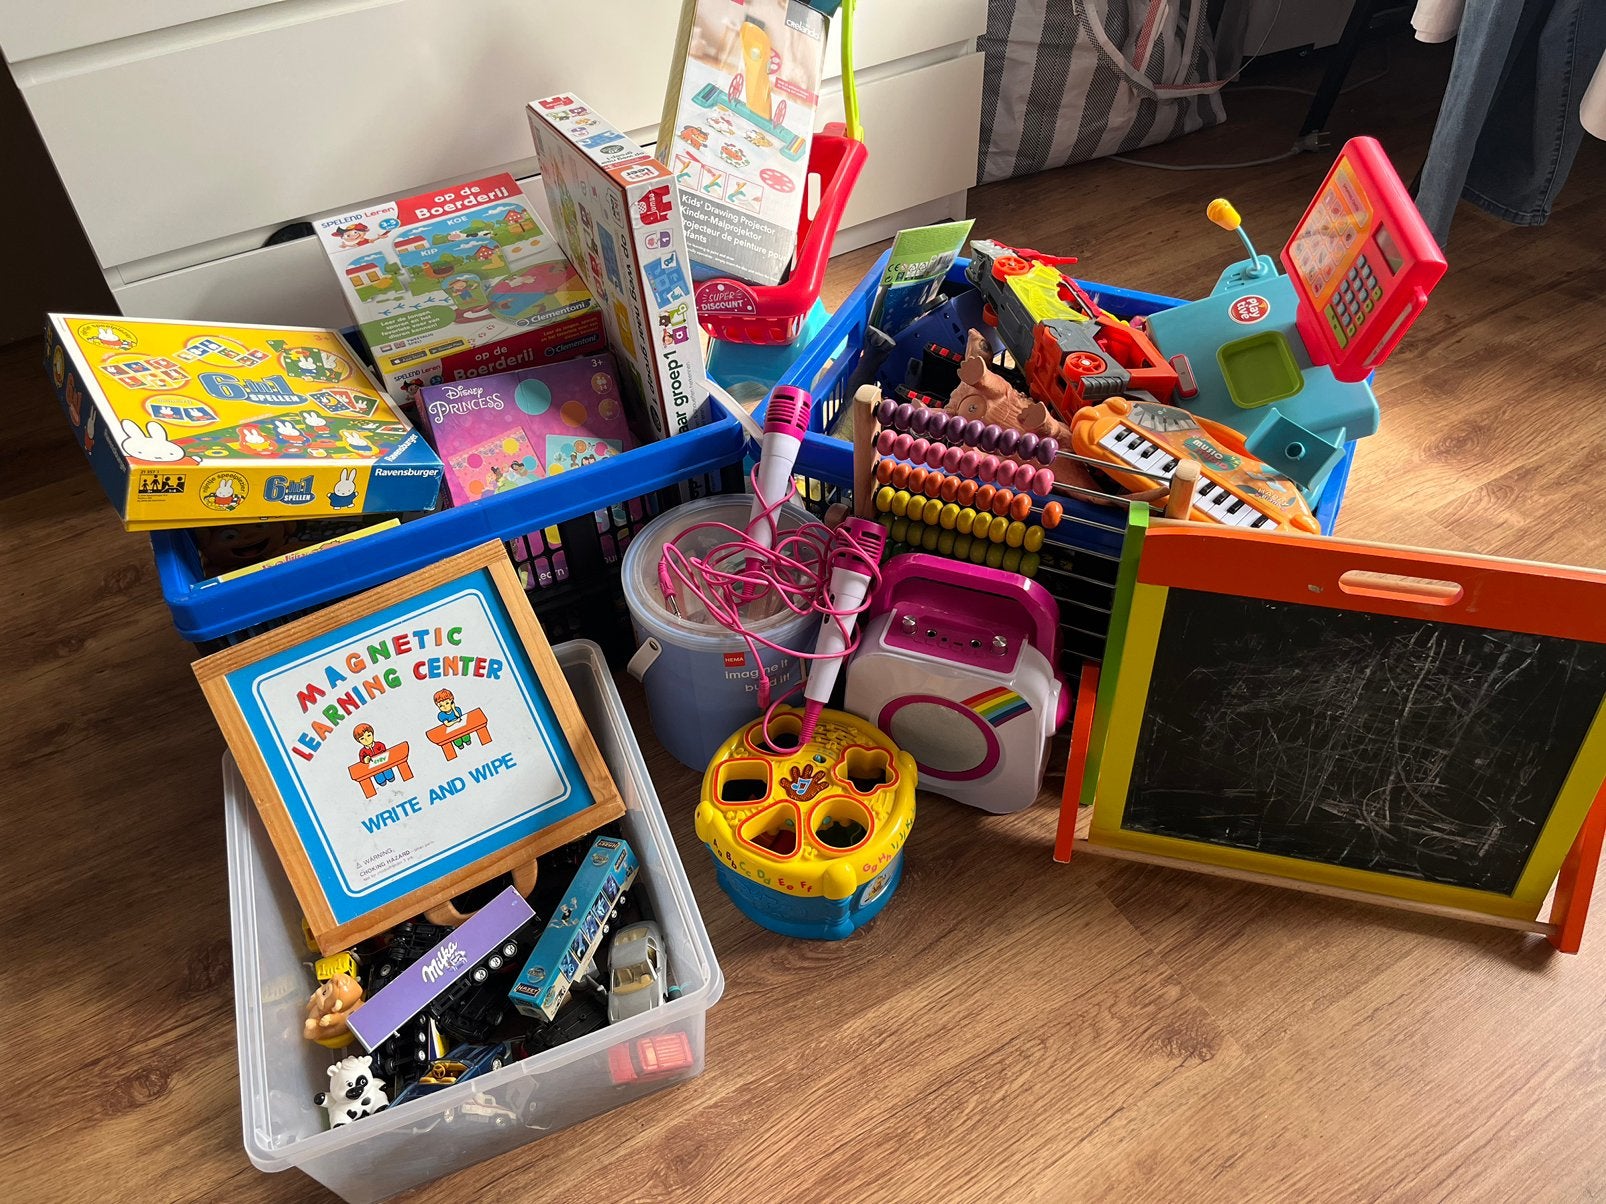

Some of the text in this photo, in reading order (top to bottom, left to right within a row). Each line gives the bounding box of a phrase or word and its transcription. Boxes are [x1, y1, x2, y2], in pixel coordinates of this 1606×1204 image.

[414, 186, 510, 219] Boerderij
[434, 184, 481, 203] op de
[321, 206, 395, 229] SPELEND Leren
[446, 215, 469, 227] KOE
[680, 194, 776, 236] Kids' Drawing Projector
[681, 218, 721, 238] rojecteur
[721, 231, 734, 242] de
[733, 236, 768, 256] peinture
[420, 247, 438, 258] KIP
[626, 264, 638, 303] weg
[701, 299, 744, 311] DISCOUNT
[708, 291, 735, 302] SUPER
[1237, 301, 1250, 319] tive
[1246, 298, 1260, 317] play
[475, 346, 508, 362] op de
[591, 358, 604, 368] 3+
[453, 348, 535, 381] Boerderij
[249, 393, 301, 402] SPELLEN
[428, 392, 505, 424] PRINCESS
[384, 433, 419, 463] Ravensburger
[374, 468, 440, 477] Ravensburger
[284, 494, 311, 502] SPELLEN
[296, 626, 464, 713] MAGNETIC
[725, 664, 779, 679] imagne
[745, 677, 777, 692] bud
[290, 655, 503, 762] LEARNING CENTER
[361, 752, 517, 835] WRITE AND WIPE
[725, 851, 738, 870] Bb
[757, 869, 771, 886] Dd
[778, 878, 795, 891] Ee
[800, 881, 813, 893] Ff
[862, 863, 878, 873] Gg
[421, 940, 459, 984] Milka
